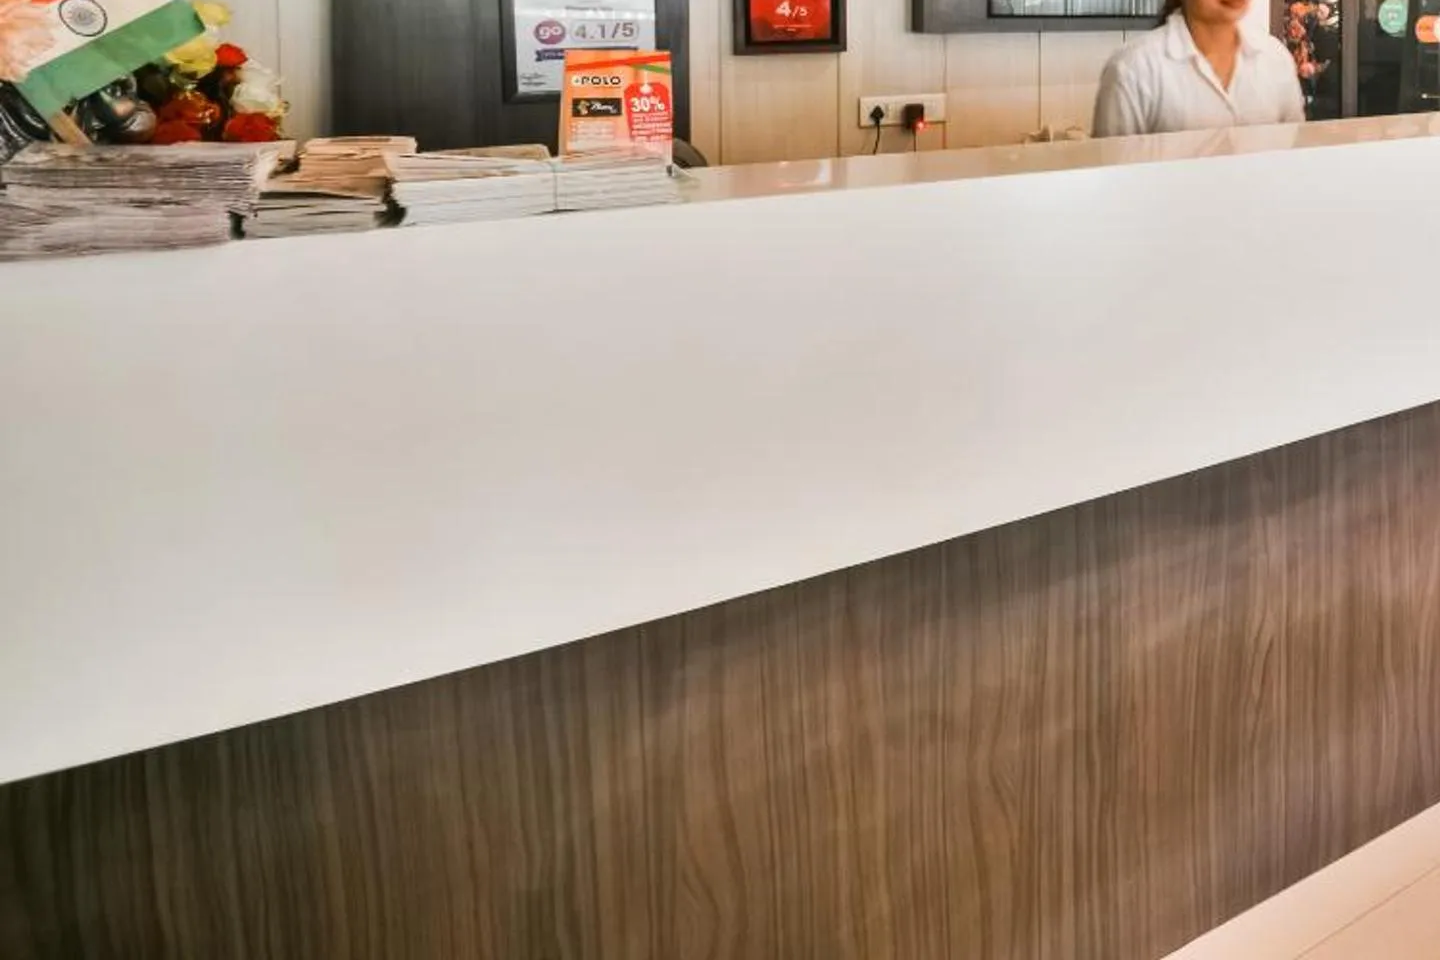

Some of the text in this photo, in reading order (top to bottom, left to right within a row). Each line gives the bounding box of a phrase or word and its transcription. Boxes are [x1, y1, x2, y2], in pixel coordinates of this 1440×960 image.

[775, 0, 808, 18] 4/5
[538, 21, 635, 39] go 4.1/5
[630, 96, 665, 113] 30%
